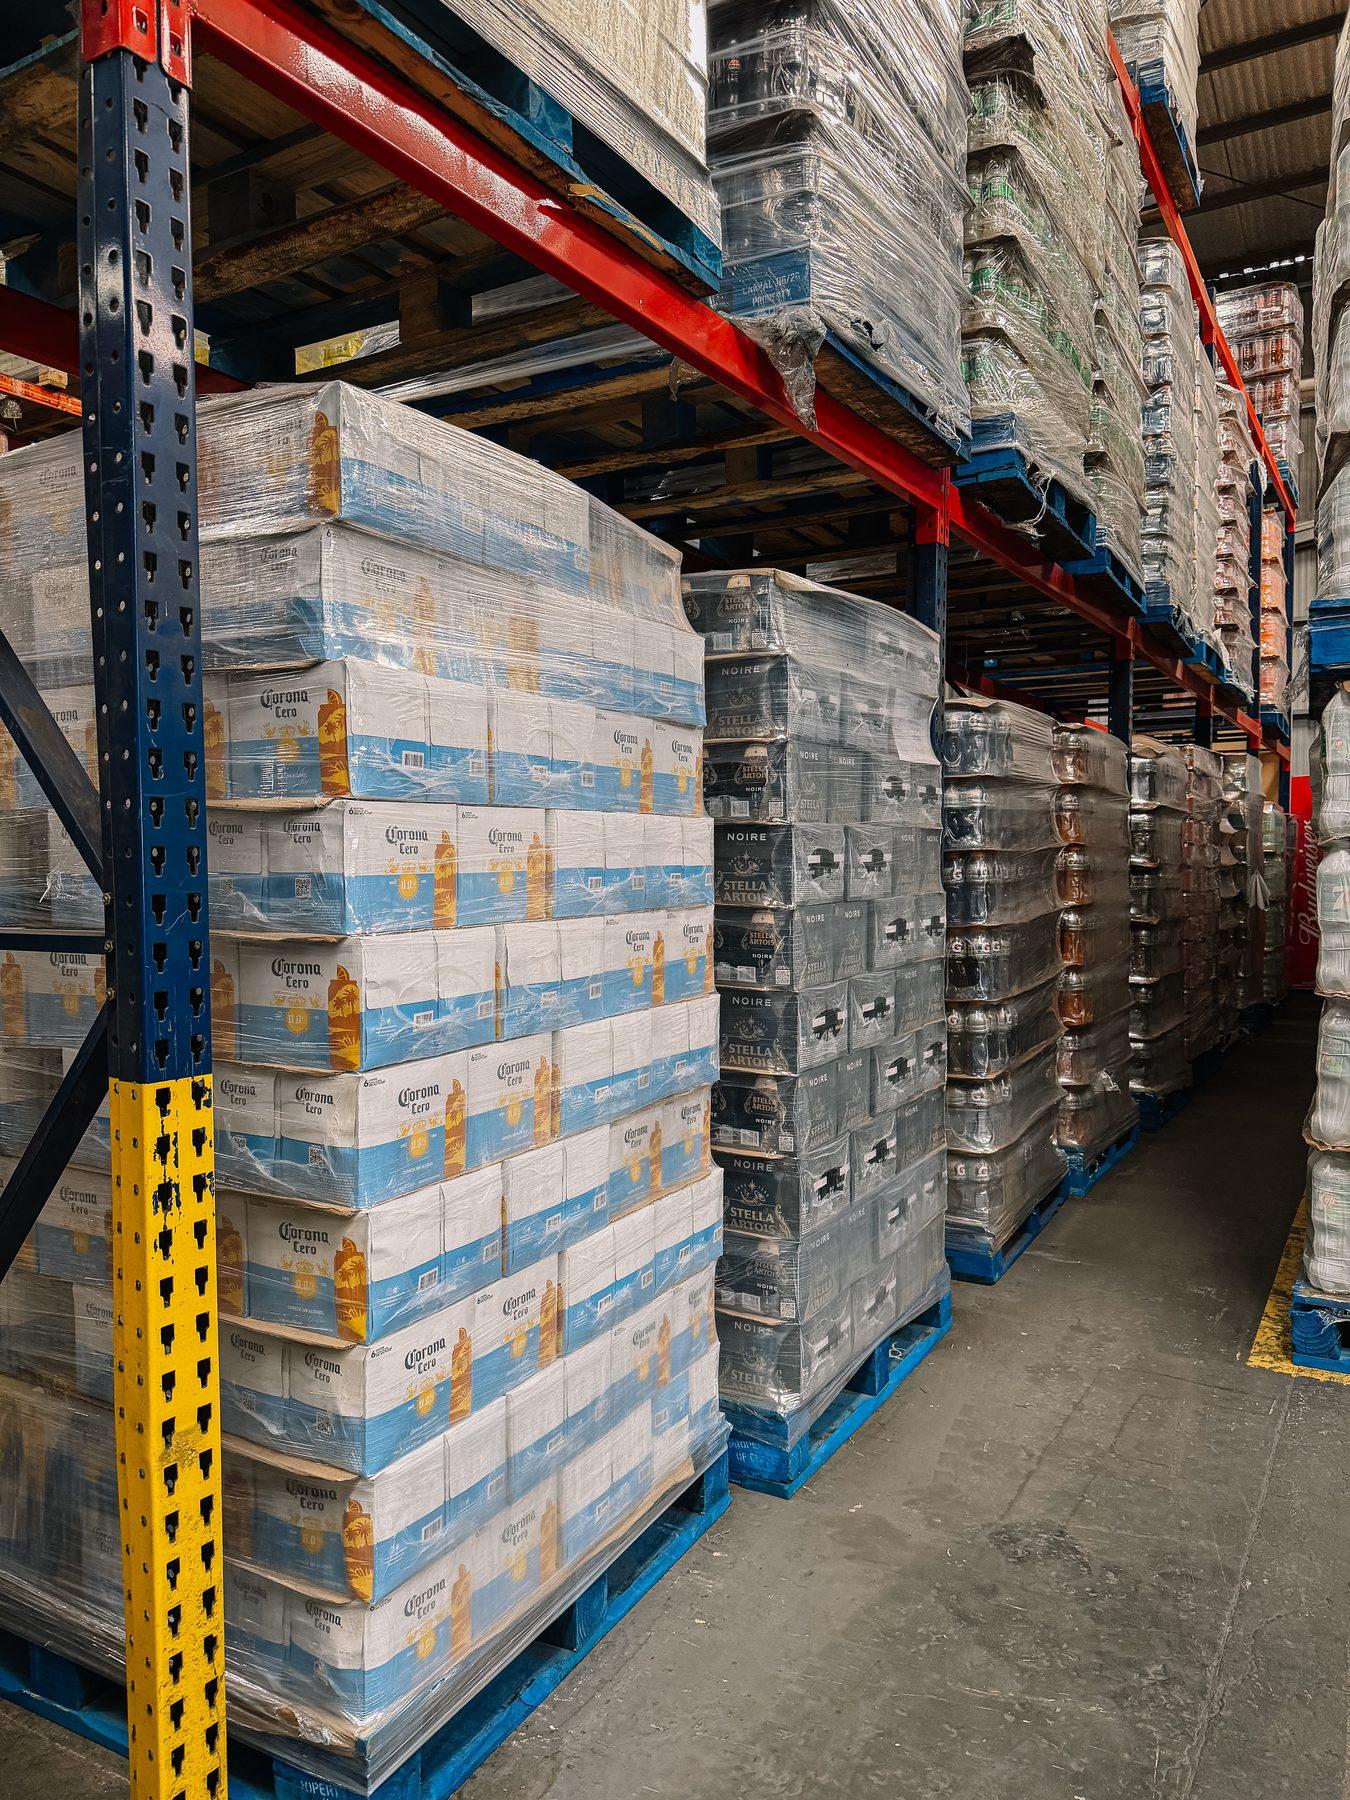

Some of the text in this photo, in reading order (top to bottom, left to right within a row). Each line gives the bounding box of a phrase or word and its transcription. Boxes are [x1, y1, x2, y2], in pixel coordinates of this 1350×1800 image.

[260, 547, 298, 562] Corona
[721, 665, 761, 676] NOIRE
[260, 688, 311, 710] Corona
[52, 709, 78, 723] orona
[275, 707, 297, 719] Cero
[613, 729, 638, 746] Corona
[671, 739, 693, 756] Corona
[801, 751, 818, 760] NOIRE
[839, 757, 855, 766] NOIRE
[742, 765, 767, 773] STELLA
[742, 772, 768, 780] ARTOIS
[348, 807, 354, 815] 6
[208, 820, 244, 840] Corona
[283, 819, 322, 838] Corona
[385, 825, 429, 846] Corona
[218, 835, 235, 845] Cero
[293, 833, 312, 844] Cero
[488, 828, 523, 846] Corona
[727, 833, 767, 841] NOIRE
[400, 843, 420, 855] Cero
[499, 843, 516, 854] Cero
[724, 880, 768, 891] STELLA
[723, 892, 768, 902] ARTOIS
[806, 914, 825, 924] NOIRE
[844, 909, 861, 918] NOIRE
[625, 930, 650, 947] Corona
[682, 924, 704, 938] Corona
[50, 952, 88, 969] Corona
[61, 966, 78, 977] Cero
[271, 958, 323, 979] Corona
[286, 975, 310, 989] Cero
[732, 996, 772, 1007] NOIRE
[729, 1043, 773, 1057] STELLA
[729, 1054, 773, 1067] ARTOIS
[846, 1058, 863, 1071] NOIRE
[497, 1058, 531, 1081] Corona
[363, 1079, 370, 1088] 6
[507, 1075, 523, 1087] Cero
[809, 1073, 828, 1087] NOIRE
[220, 1079, 257, 1097] Corona
[230, 1094, 248, 1106] Cero
[295, 1086, 336, 1107] Corona
[397, 1083, 441, 1109] Corona
[752, 1096, 776, 1105] STELLA
[305, 1102, 323, 1116] Cero
[411, 1100, 431, 1115] Cero
[681, 1103, 702, 1120] Corona
[752, 1103, 777, 1113] ARTOIS
[755, 1118, 776, 1126] NOIRE
[624, 1124, 649, 1144] Corona
[734, 1159, 773, 1173] NOIRE
[60, 1186, 98, 1205] Corona
[71, 1202, 89, 1216] Cero
[730, 1207, 775, 1224] STELLA
[278, 1221, 331, 1246] Corona
[731, 1218, 776, 1234] ARTOIS
[293, 1241, 318, 1256] Cero
[757, 1282, 778, 1291] NOIRE
[502, 1287, 537, 1316] Corona
[86, 1302, 113, 1319] Coron
[513, 1305, 529, 1321] Cero
[230, 1332, 266, 1357] Corona
[240, 1349, 257, 1363] Cero
[370, 1349, 376, 1359] 6
[404, 1337, 447, 1370] Corona
[304, 1351, 343, 1377] Corona
[417, 1356, 437, 1375] Cero
[314, 1368, 332, 1384] Cero
[730, 1368, 775, 1386] STELLA
[285, 1478, 338, 1501] Corona
[300, 1496, 326, 1512] Cero
[502, 1509, 537, 1544] Corona
[404, 1578, 448, 1618] Corona
[305, 1600, 343, 1629] Corona
[417, 1600, 436, 1620] Cero
[314, 1618, 332, 1634] Cero
